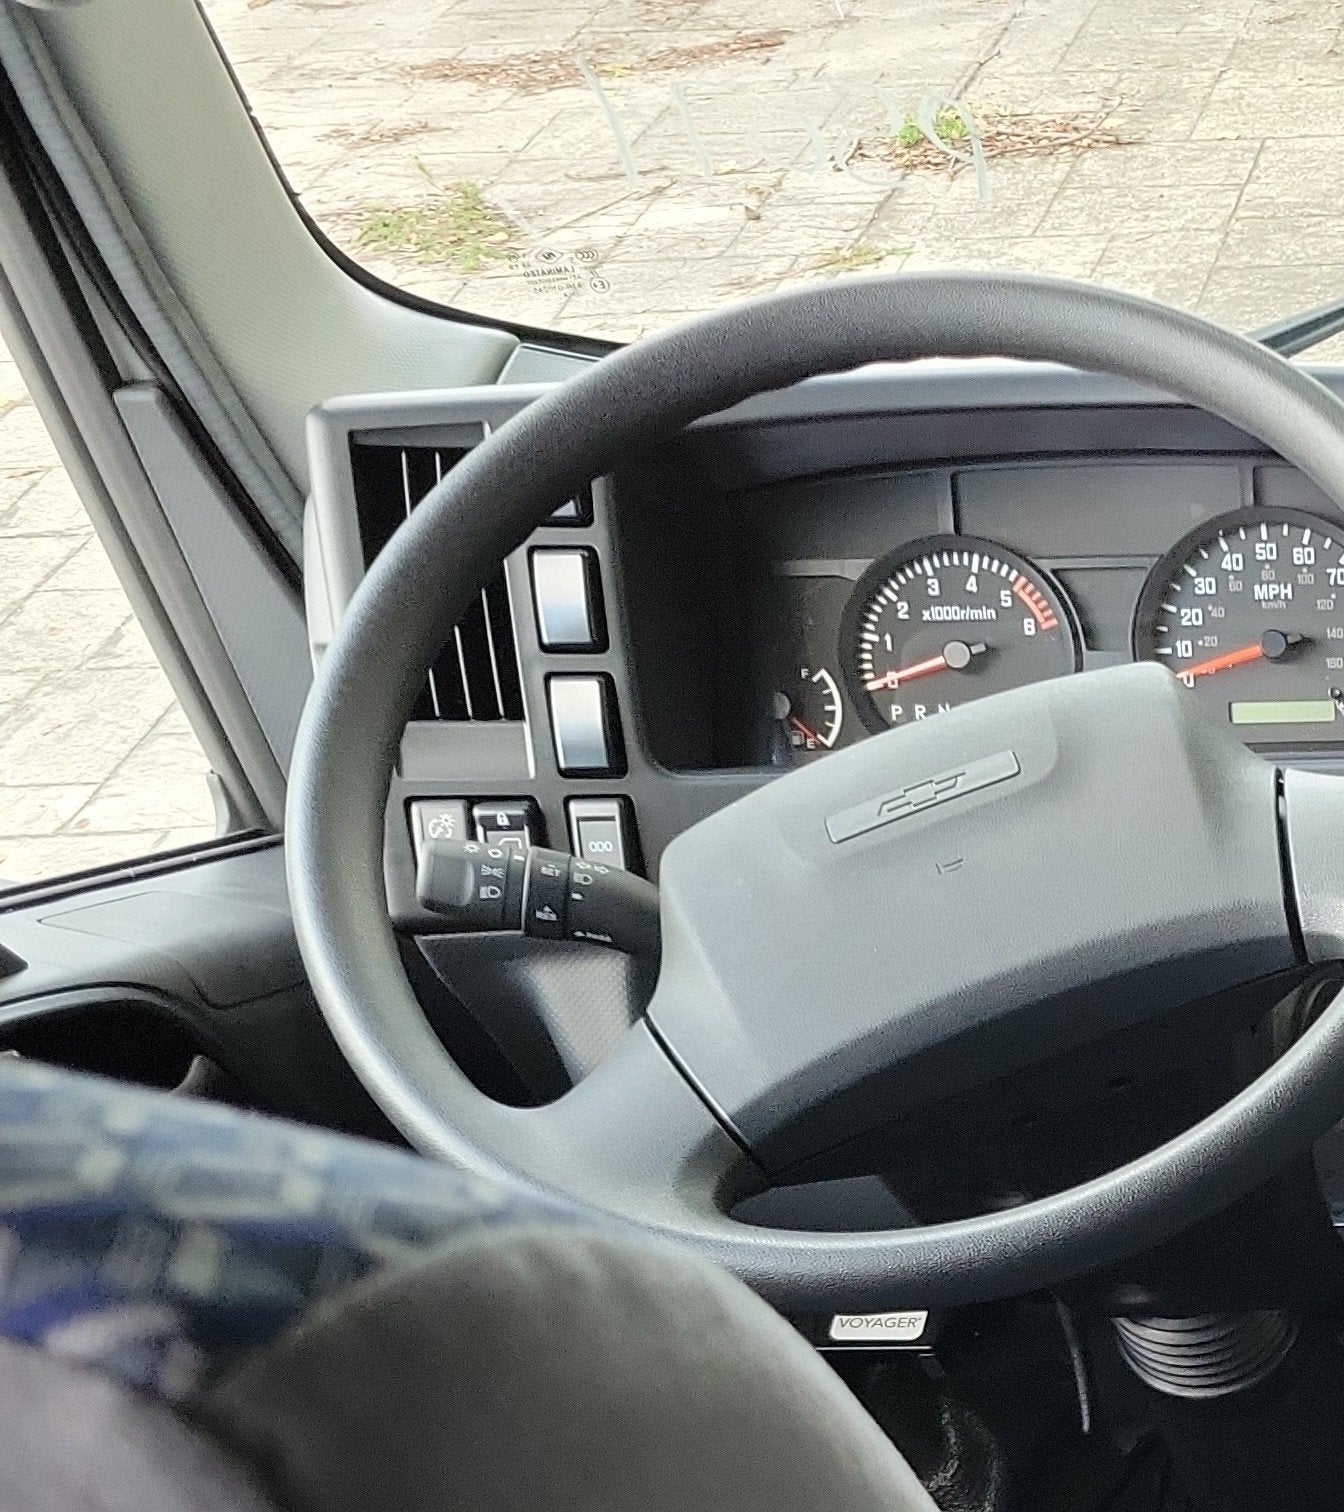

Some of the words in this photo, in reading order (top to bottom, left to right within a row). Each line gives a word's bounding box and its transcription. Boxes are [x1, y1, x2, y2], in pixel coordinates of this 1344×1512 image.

[1256, 543, 1276, 560] 50
[1293, 548, 1314, 565] 60
[1222, 554, 1243, 570] 40
[927, 580, 940, 595] 3
[966, 575, 978, 593] 4
[1195, 578, 1216, 594] 30
[1254, 584, 1293, 599] MPH
[1001, 590, 1012, 607] 5
[1262, 600, 1286, 609] km/h
[897, 601, 909, 619] 2
[1181, 609, 1203, 625] 20
[1024, 618, 1036, 635] 6
[884, 633, 892, 651] 1
[1176, 640, 1192, 657] 10
[801, 668, 809, 679] F
[892, 705, 902, 720] P
[915, 704, 926, 719] R
